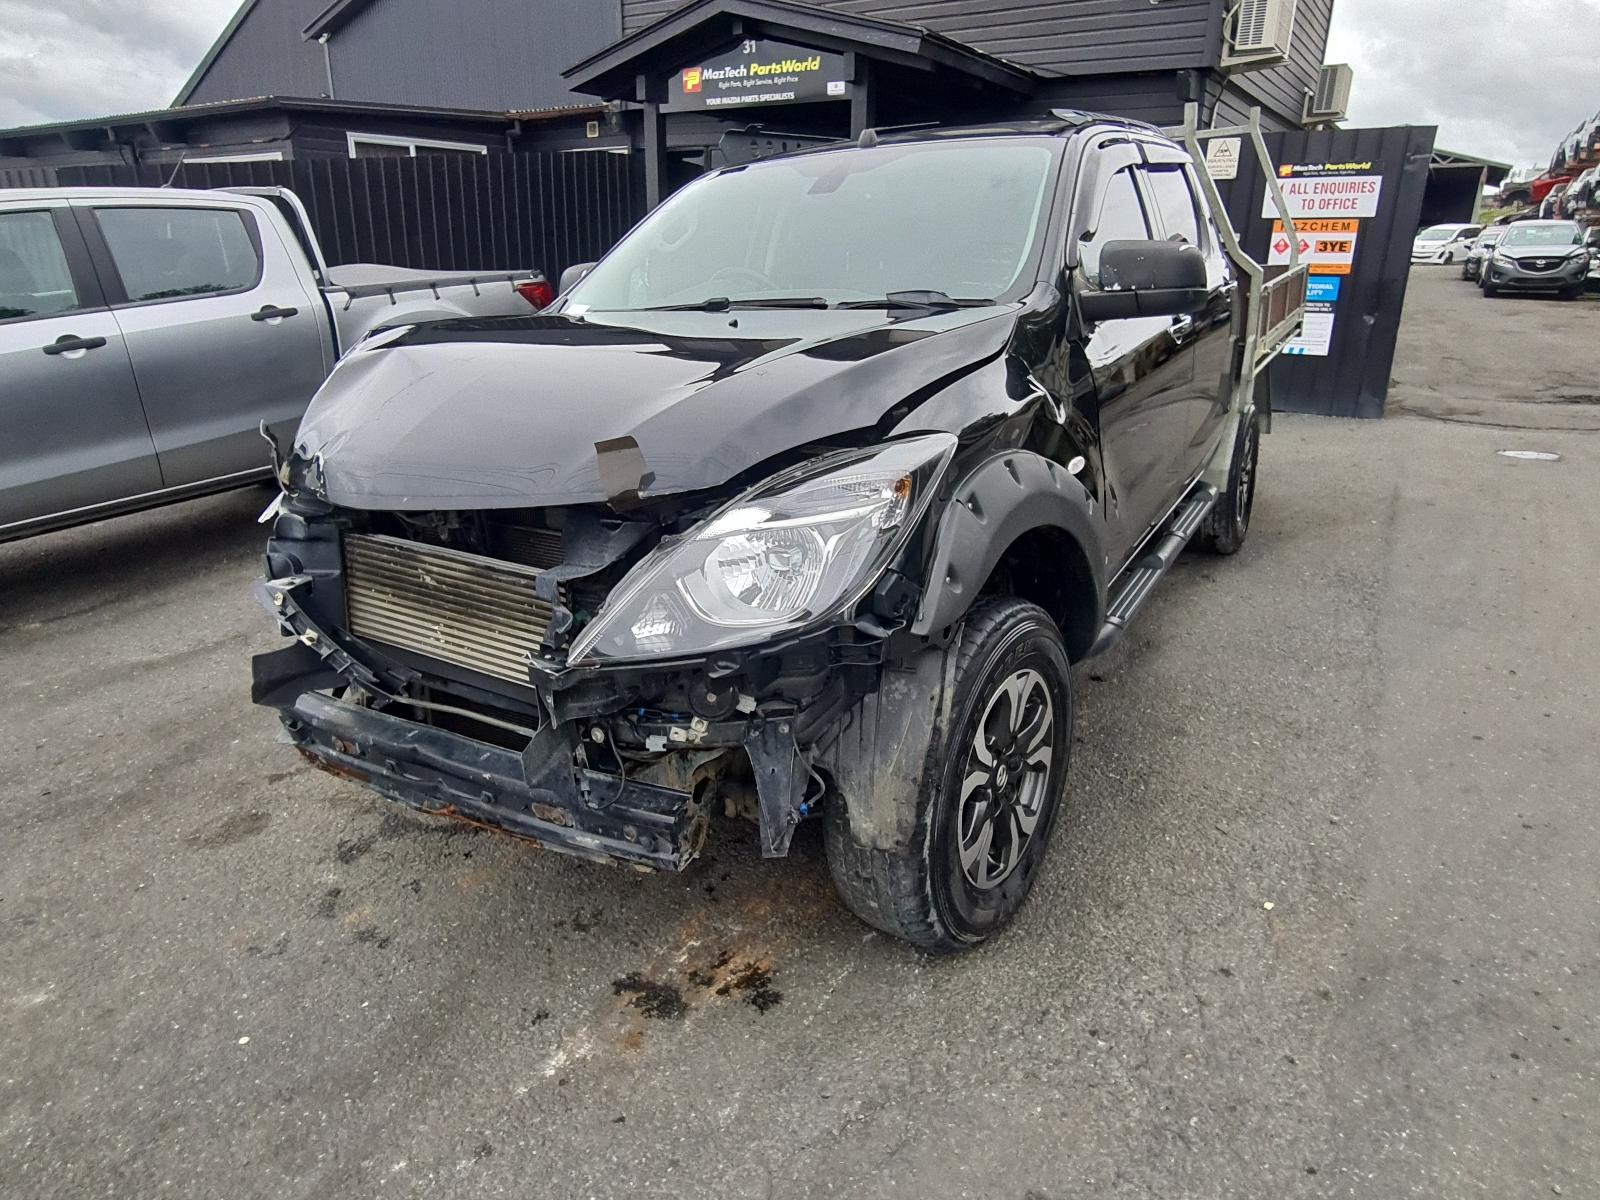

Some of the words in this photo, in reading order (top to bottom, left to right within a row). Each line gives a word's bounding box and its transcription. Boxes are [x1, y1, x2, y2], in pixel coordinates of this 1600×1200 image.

[742, 39, 756, 54] 31
[702, 64, 747, 80] MazTech
[749, 56, 821, 76] PartsWorld
[706, 97, 721, 106] YOUR
[721, 96, 741, 104] MAZDA
[741, 94, 759, 103] PARTS
[759, 92, 795, 102] SPECIALISTS
[1324, 162, 1371, 170] PartsWorld
[1289, 183, 1309, 195] ALL
[1313, 181, 1376, 195] ENQUIRIES
[1301, 198, 1315, 210] TO
[1318, 198, 1358, 210] OFFICE
[1280, 221, 1351, 231] ZCHEM
[1318, 241, 1348, 252] 3YE
